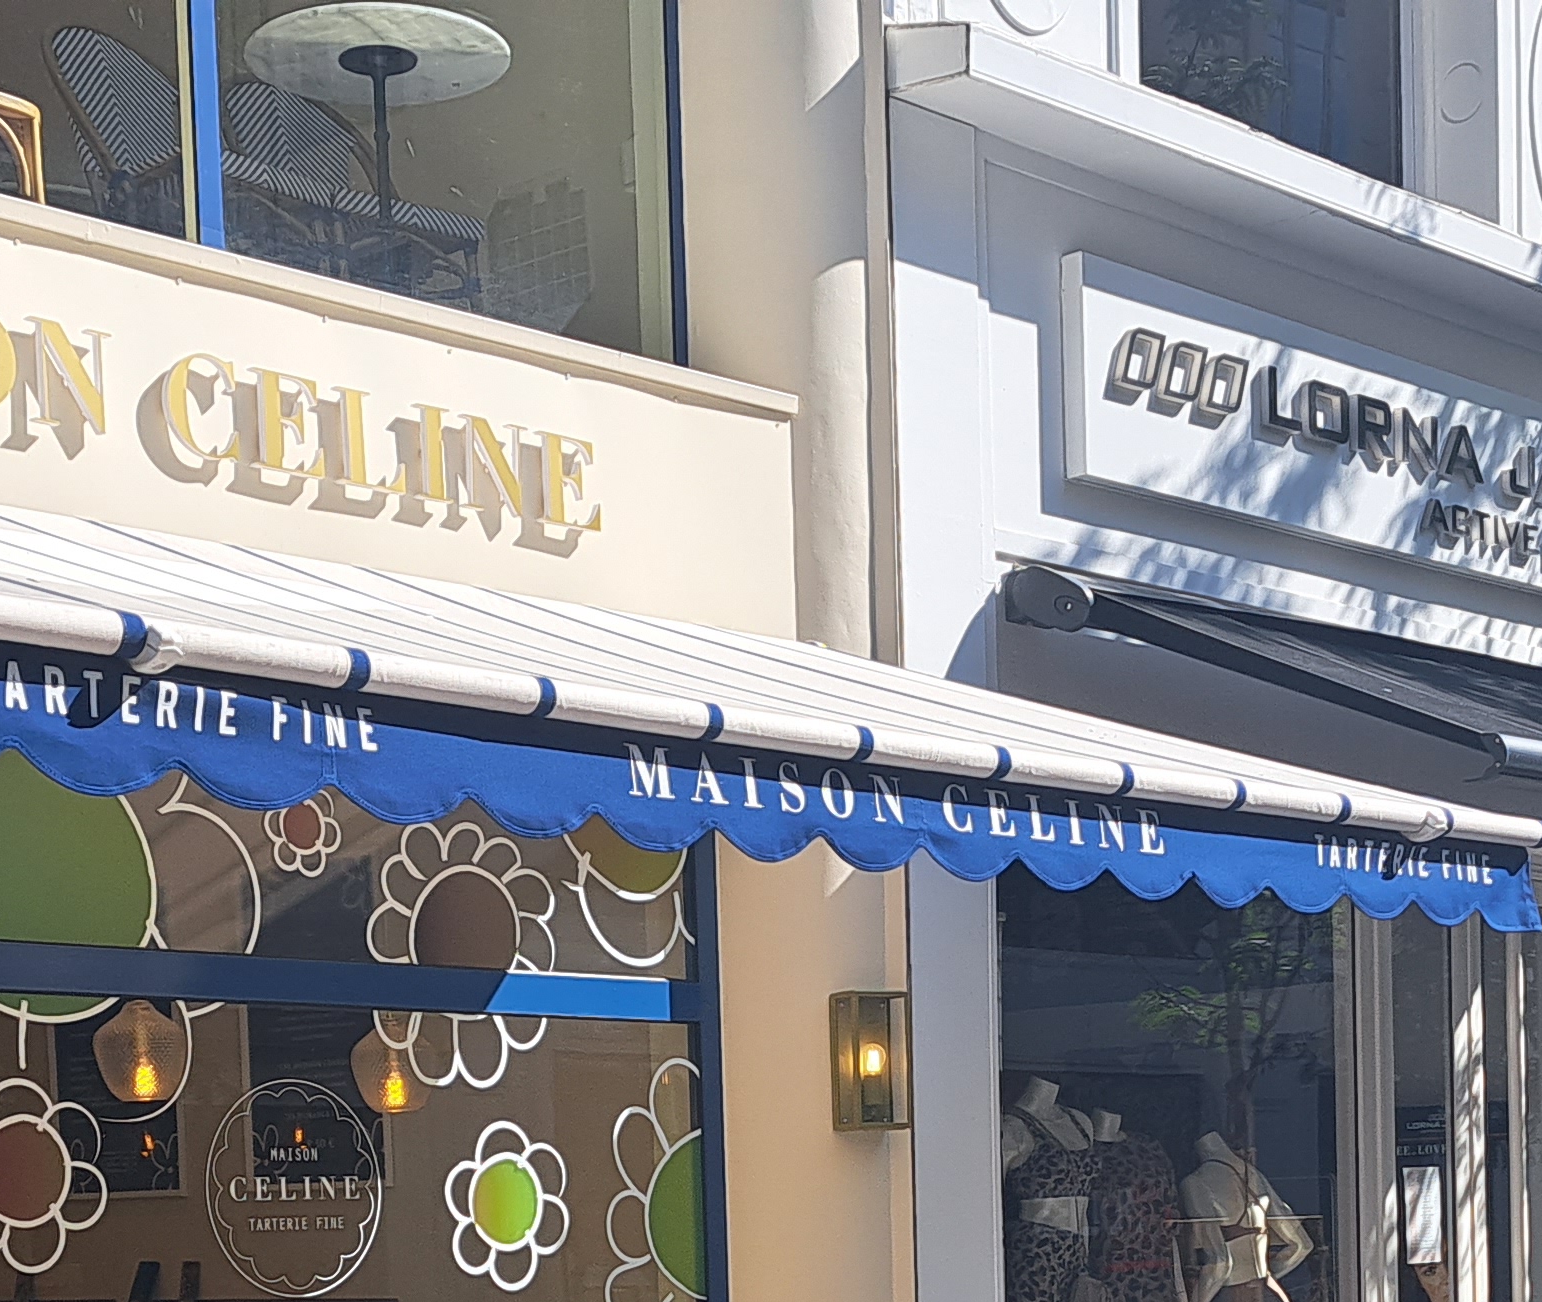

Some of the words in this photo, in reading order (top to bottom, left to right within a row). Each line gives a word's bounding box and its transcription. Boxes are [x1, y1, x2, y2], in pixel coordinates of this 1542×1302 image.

[162, 353, 602, 533] CELINE
[1265, 364, 1485, 487] LORNA
[1423, 497, 1539, 553] ACTIVE
[271, 695, 379, 751] FINE
[623, 742, 905, 825] MAISON
[942, 783, 1166, 856] CELINE
[1314, 833, 1430, 878] TARTERIE
[1441, 848, 1494, 885] FINE
[270, 1147, 319, 1162] MAISON
[229, 1174, 360, 1202] CELINE
[249, 1216, 309, 1232] TARTERIE
[315, 1216, 345, 1230] FINE
